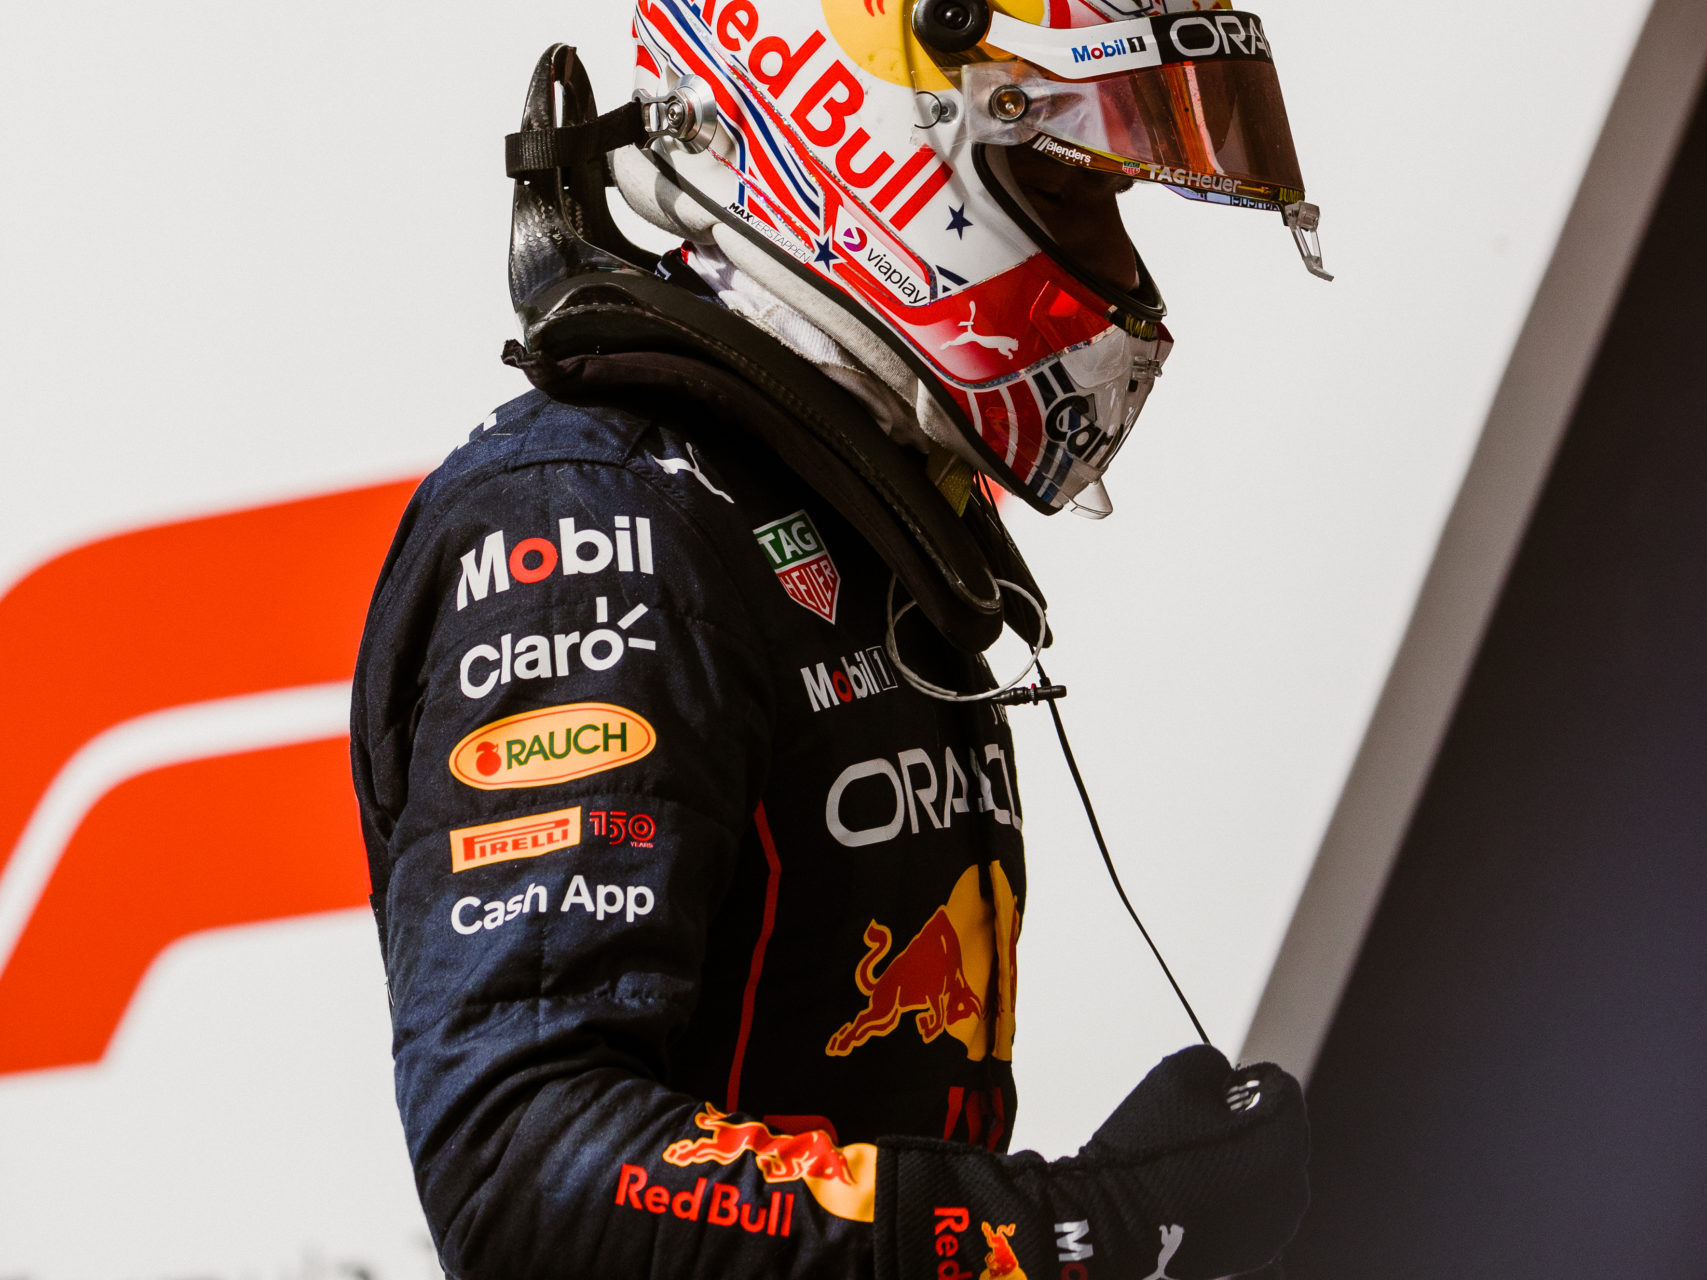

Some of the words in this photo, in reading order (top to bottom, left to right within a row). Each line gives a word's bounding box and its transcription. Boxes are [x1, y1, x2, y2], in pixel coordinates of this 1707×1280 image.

[1071, 39, 1127, 63] Mobil
[1169, 15, 1273, 58] ORA
[1046, 141, 1091, 163] Blenders
[867, 248, 927, 304] viaplay
[1045, 395, 1124, 469] Car
[457, 516, 654, 612] Mobil
[757, 521, 818, 564] TAG
[779, 558, 836, 616] HEUER
[460, 628, 624, 699] Claro
[800, 650, 880, 712] Mobil
[505, 722, 627, 770] RAUCH
[462, 818, 570, 862] PIRELLI
[451, 882, 547, 935] Cash
[560, 875, 655, 923] App
